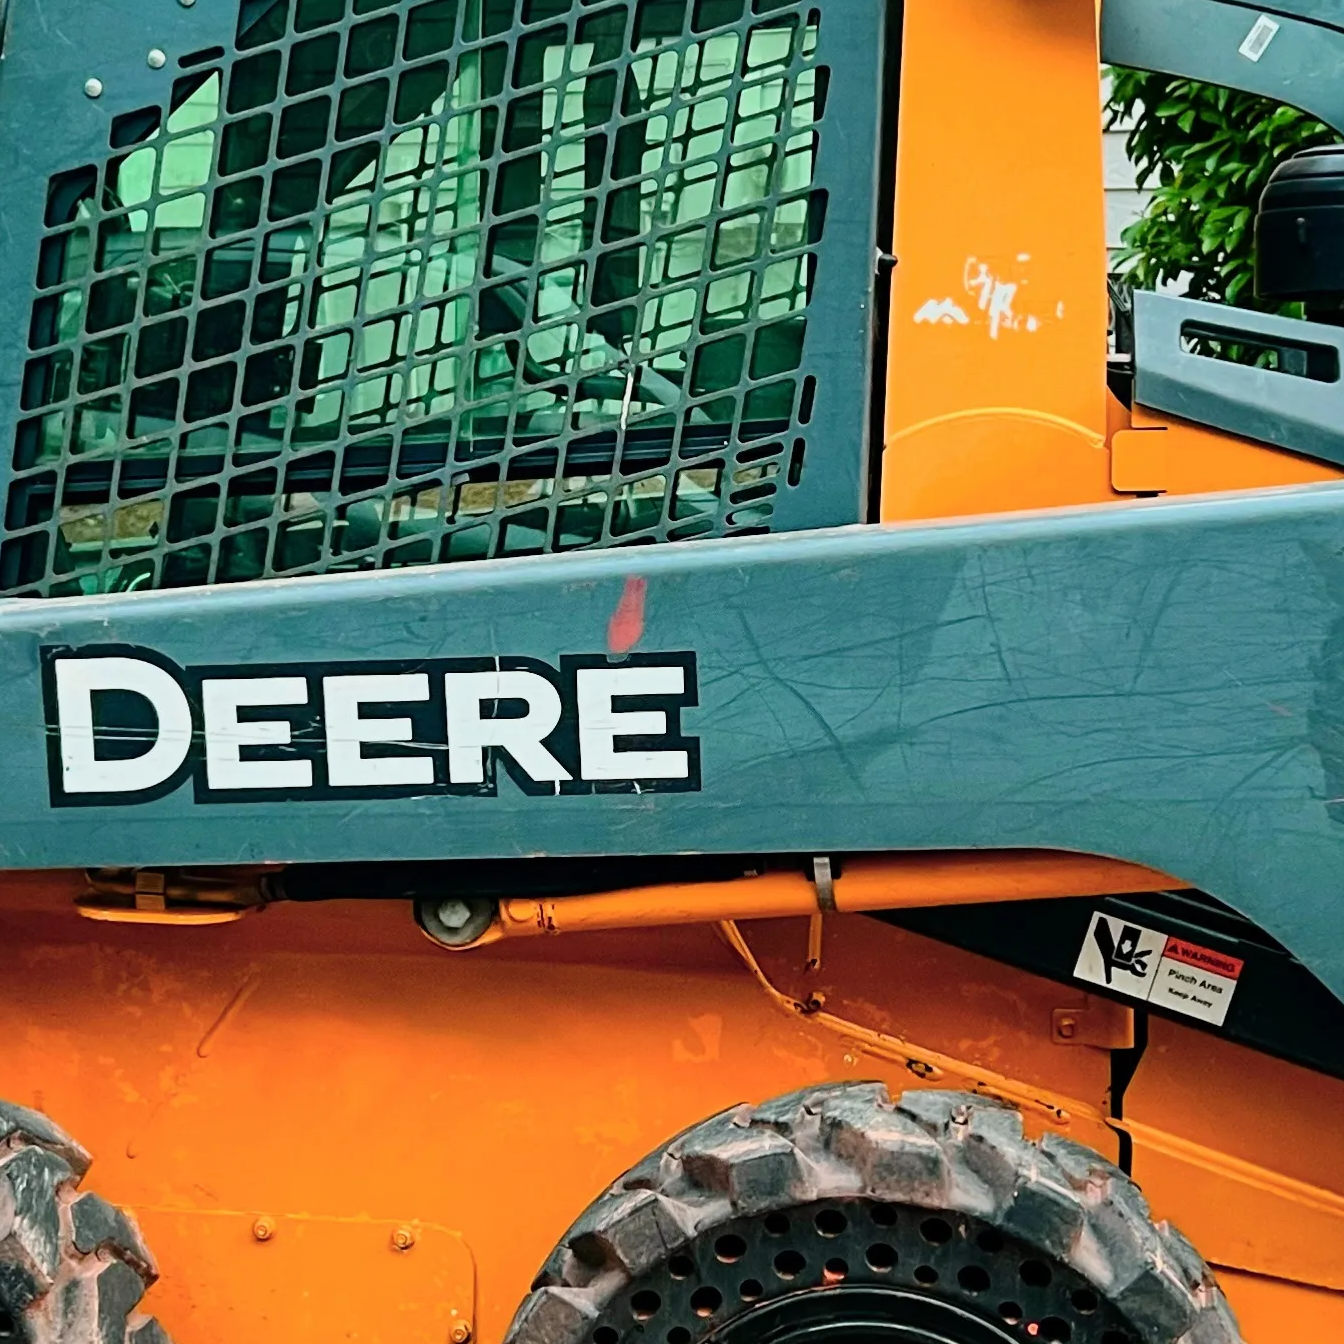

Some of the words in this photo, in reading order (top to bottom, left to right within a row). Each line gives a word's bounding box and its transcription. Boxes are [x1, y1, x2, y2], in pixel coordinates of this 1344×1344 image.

[54, 656, 689, 794] DEERE
[1182, 948, 1234, 972] WARNING
[1168, 969, 1197, 985] Pinch
[1199, 980, 1223, 994] Area
[1168, 988, 1189, 999] Keep
[1191, 995, 1213, 1008] Away
